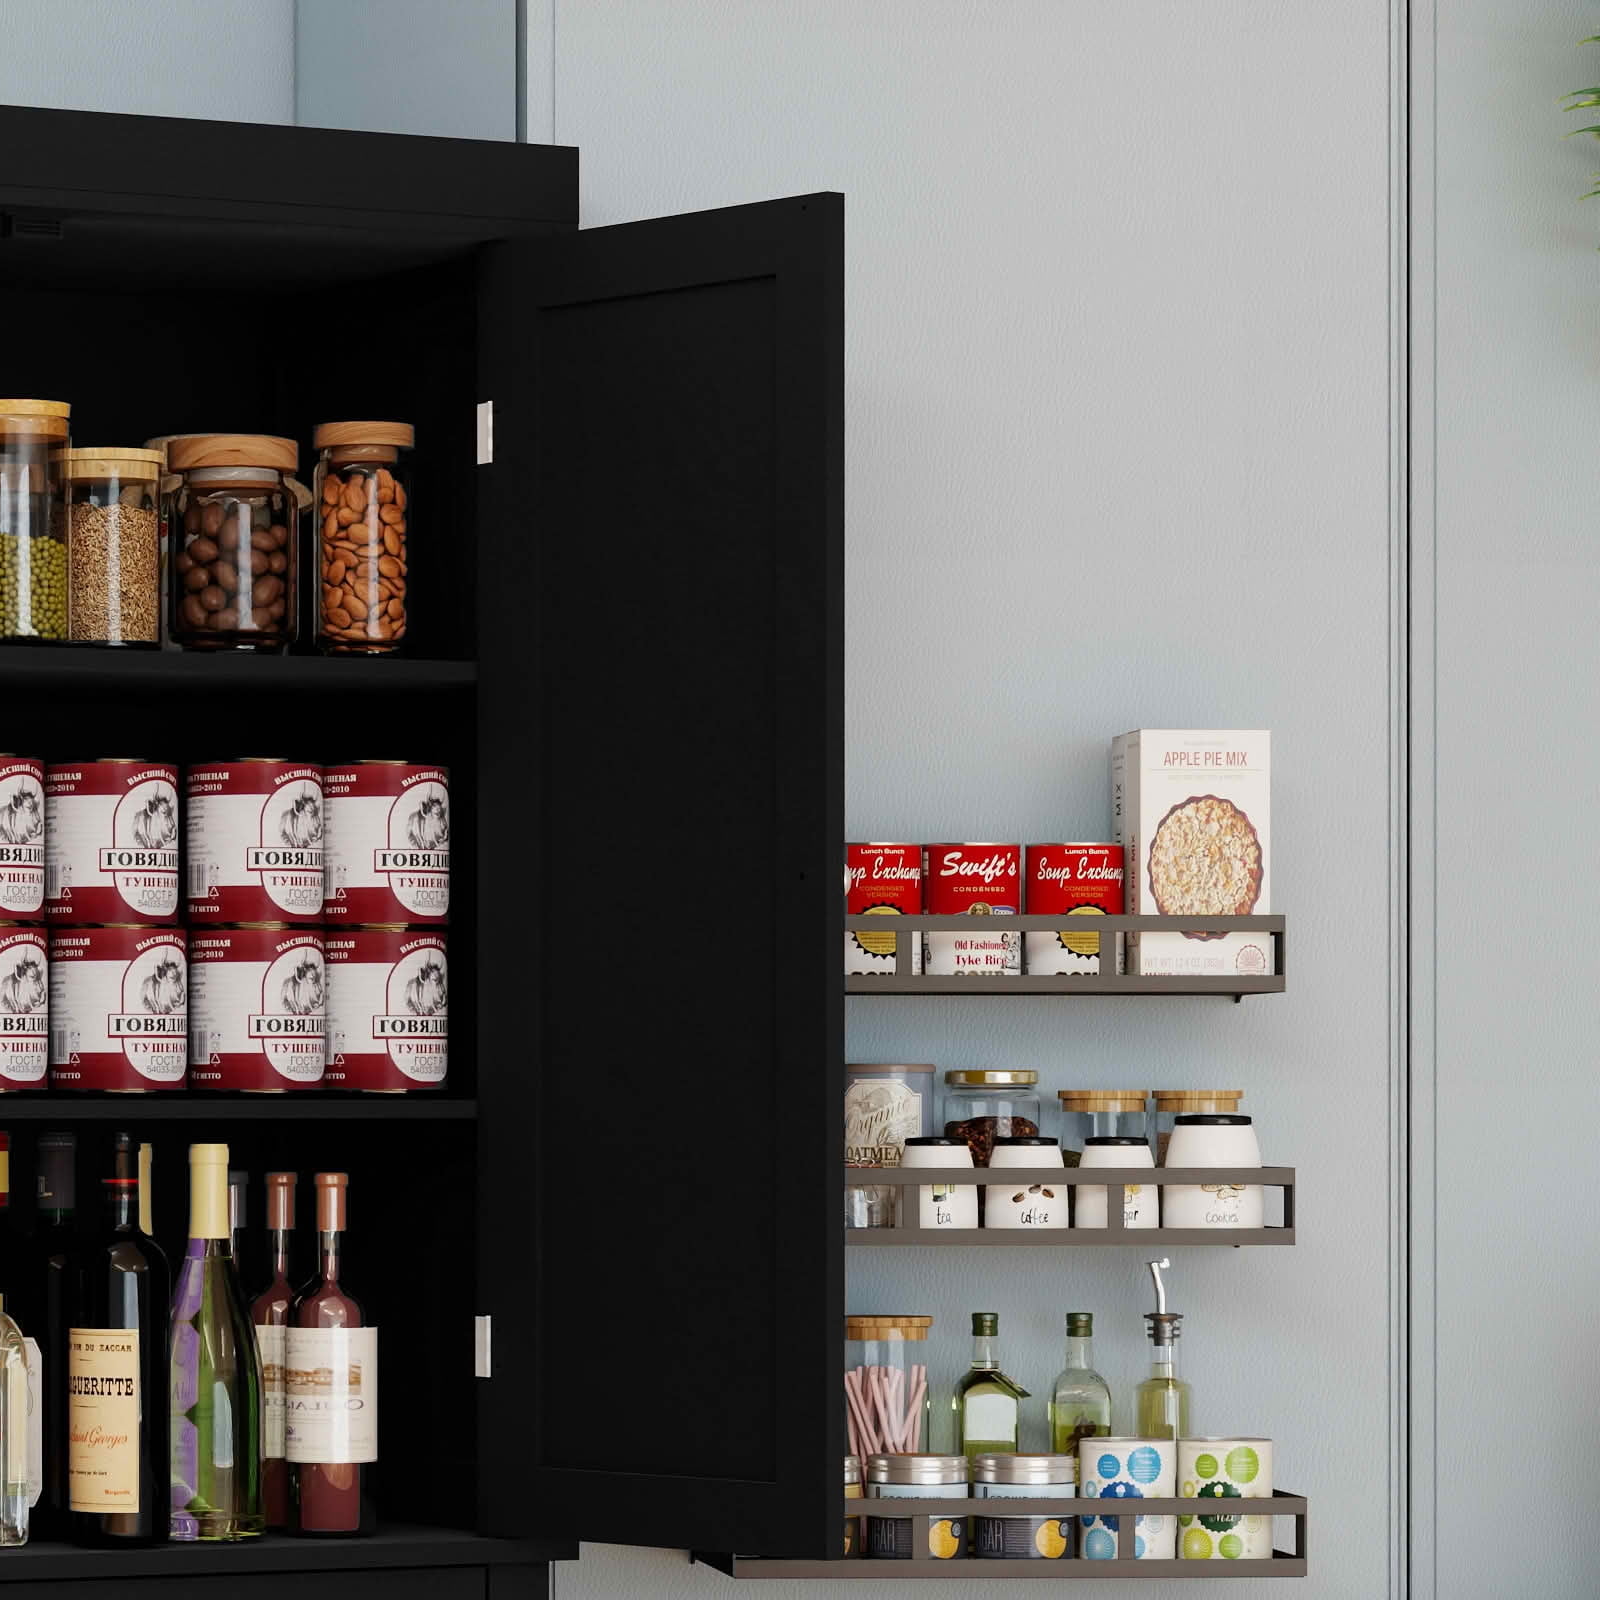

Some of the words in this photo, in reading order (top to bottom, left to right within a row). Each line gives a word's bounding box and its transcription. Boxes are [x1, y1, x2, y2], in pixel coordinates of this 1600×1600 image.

[1164, 751, 1200, 766] APPLE
[1204, 751, 1222, 766] PIE
[1226, 751, 1248, 766] MIX
[127, 769, 165, 785] ВЫСШИЙ
[274, 768, 312, 785] ВЫСШИЙ
[401, 771, 438, 787] ВЫСШИЙ
[940, 851, 1017, 884] Swift's
[1037, 857, 1071, 888] Soup
[136, 934, 173, 951] ВЫСШИЙ
[276, 936, 313, 952] ВЫСШИЙ
[400, 937, 437, 954] ВЫСШИЙ
[955, 940, 968, 950] Old
[955, 955, 981, 966] Tyke
[936, 1206, 952, 1224] tea
[1021, 1208, 1049, 1225] coffee
